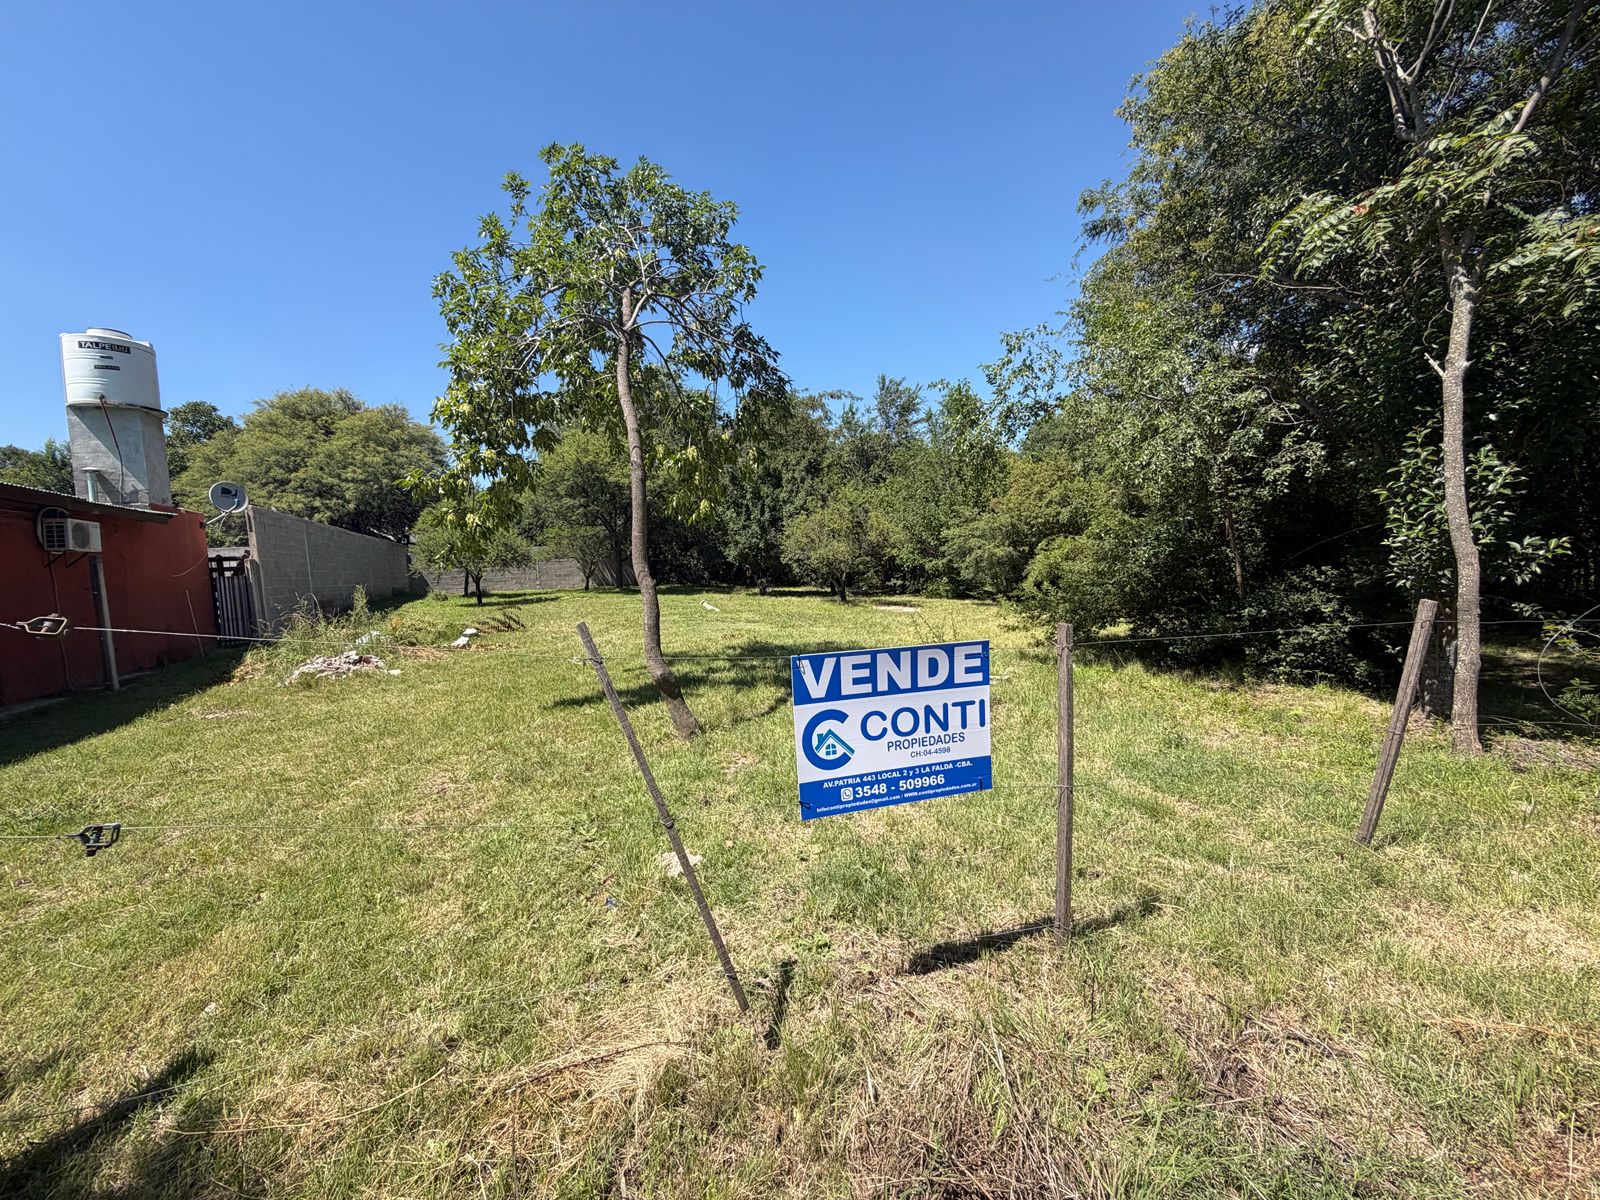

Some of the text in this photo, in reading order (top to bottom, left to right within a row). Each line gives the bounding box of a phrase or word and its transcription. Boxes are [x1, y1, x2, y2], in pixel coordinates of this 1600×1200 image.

[796, 644, 983, 699] VENDE
[860, 698, 985, 741] CONTI
[887, 732, 965, 752] PROPIEDADES
[910, 746, 951, 758] CH:04-4598
[823, 777, 861, 789] AV.PATRIA
[862, 774, 876, 782] 443
[877, 770, 901, 780] LOCAL
[931, 763, 954, 772] FALDA
[855, 783, 887, 798] 3548
[898, 774, 945, 791] 509966
